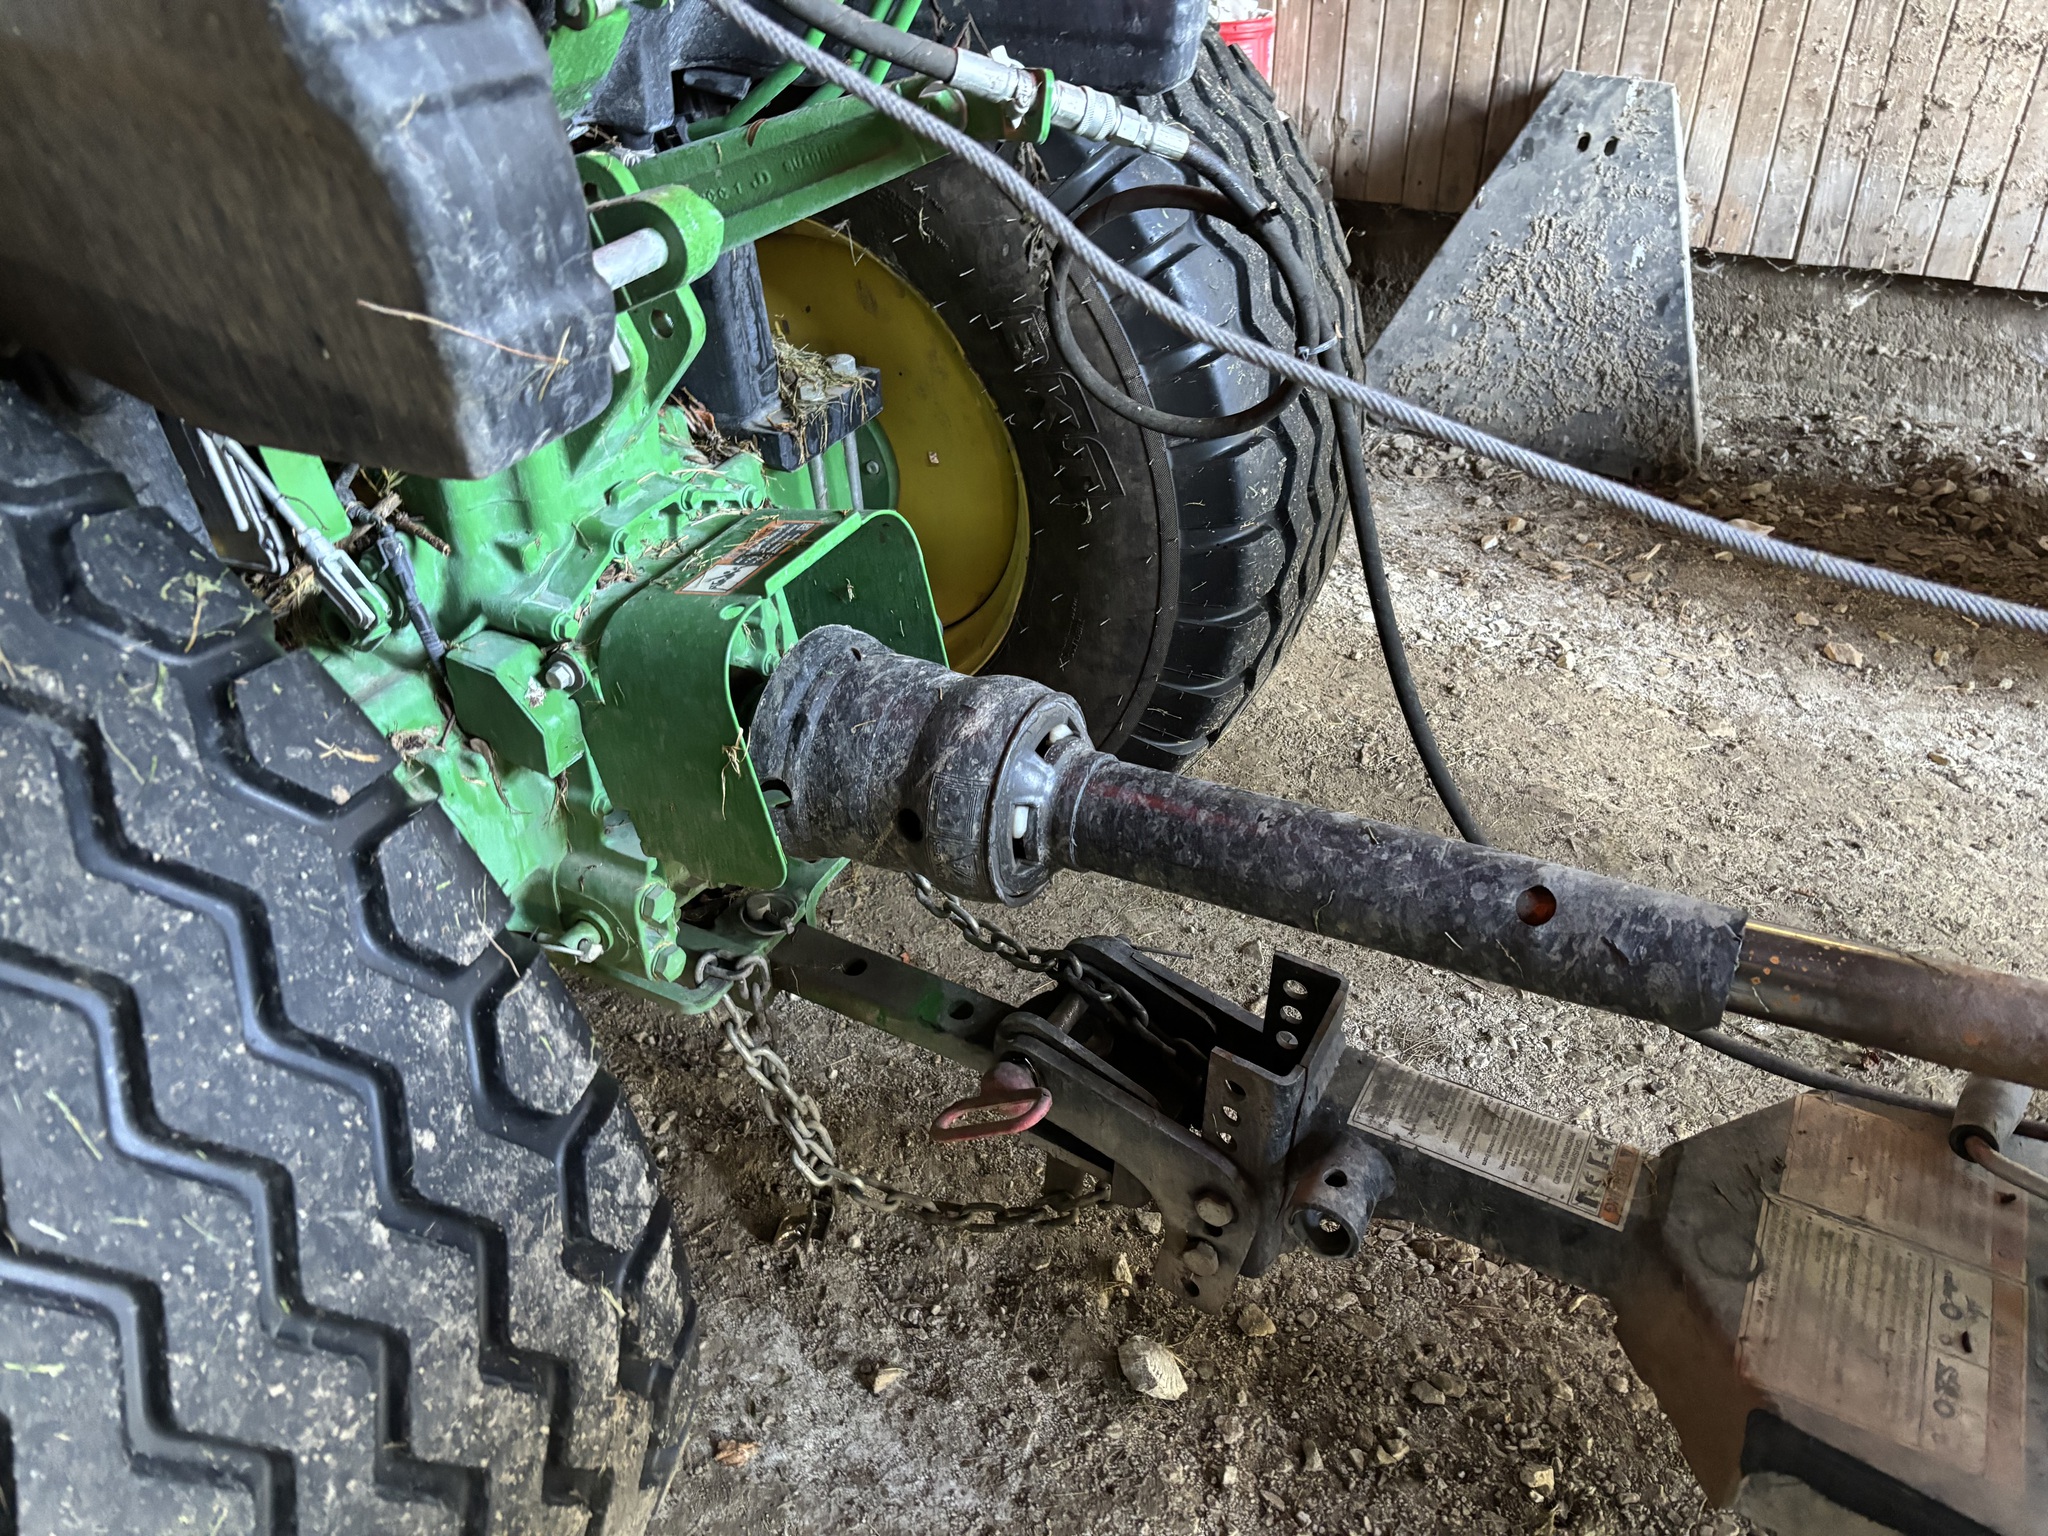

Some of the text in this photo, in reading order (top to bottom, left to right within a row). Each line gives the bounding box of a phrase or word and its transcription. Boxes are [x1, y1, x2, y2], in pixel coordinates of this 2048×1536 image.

[1552, 1130, 1576, 1185] PINCHING HAZARD
[1566, 1138, 1583, 1171] CRUSHING
